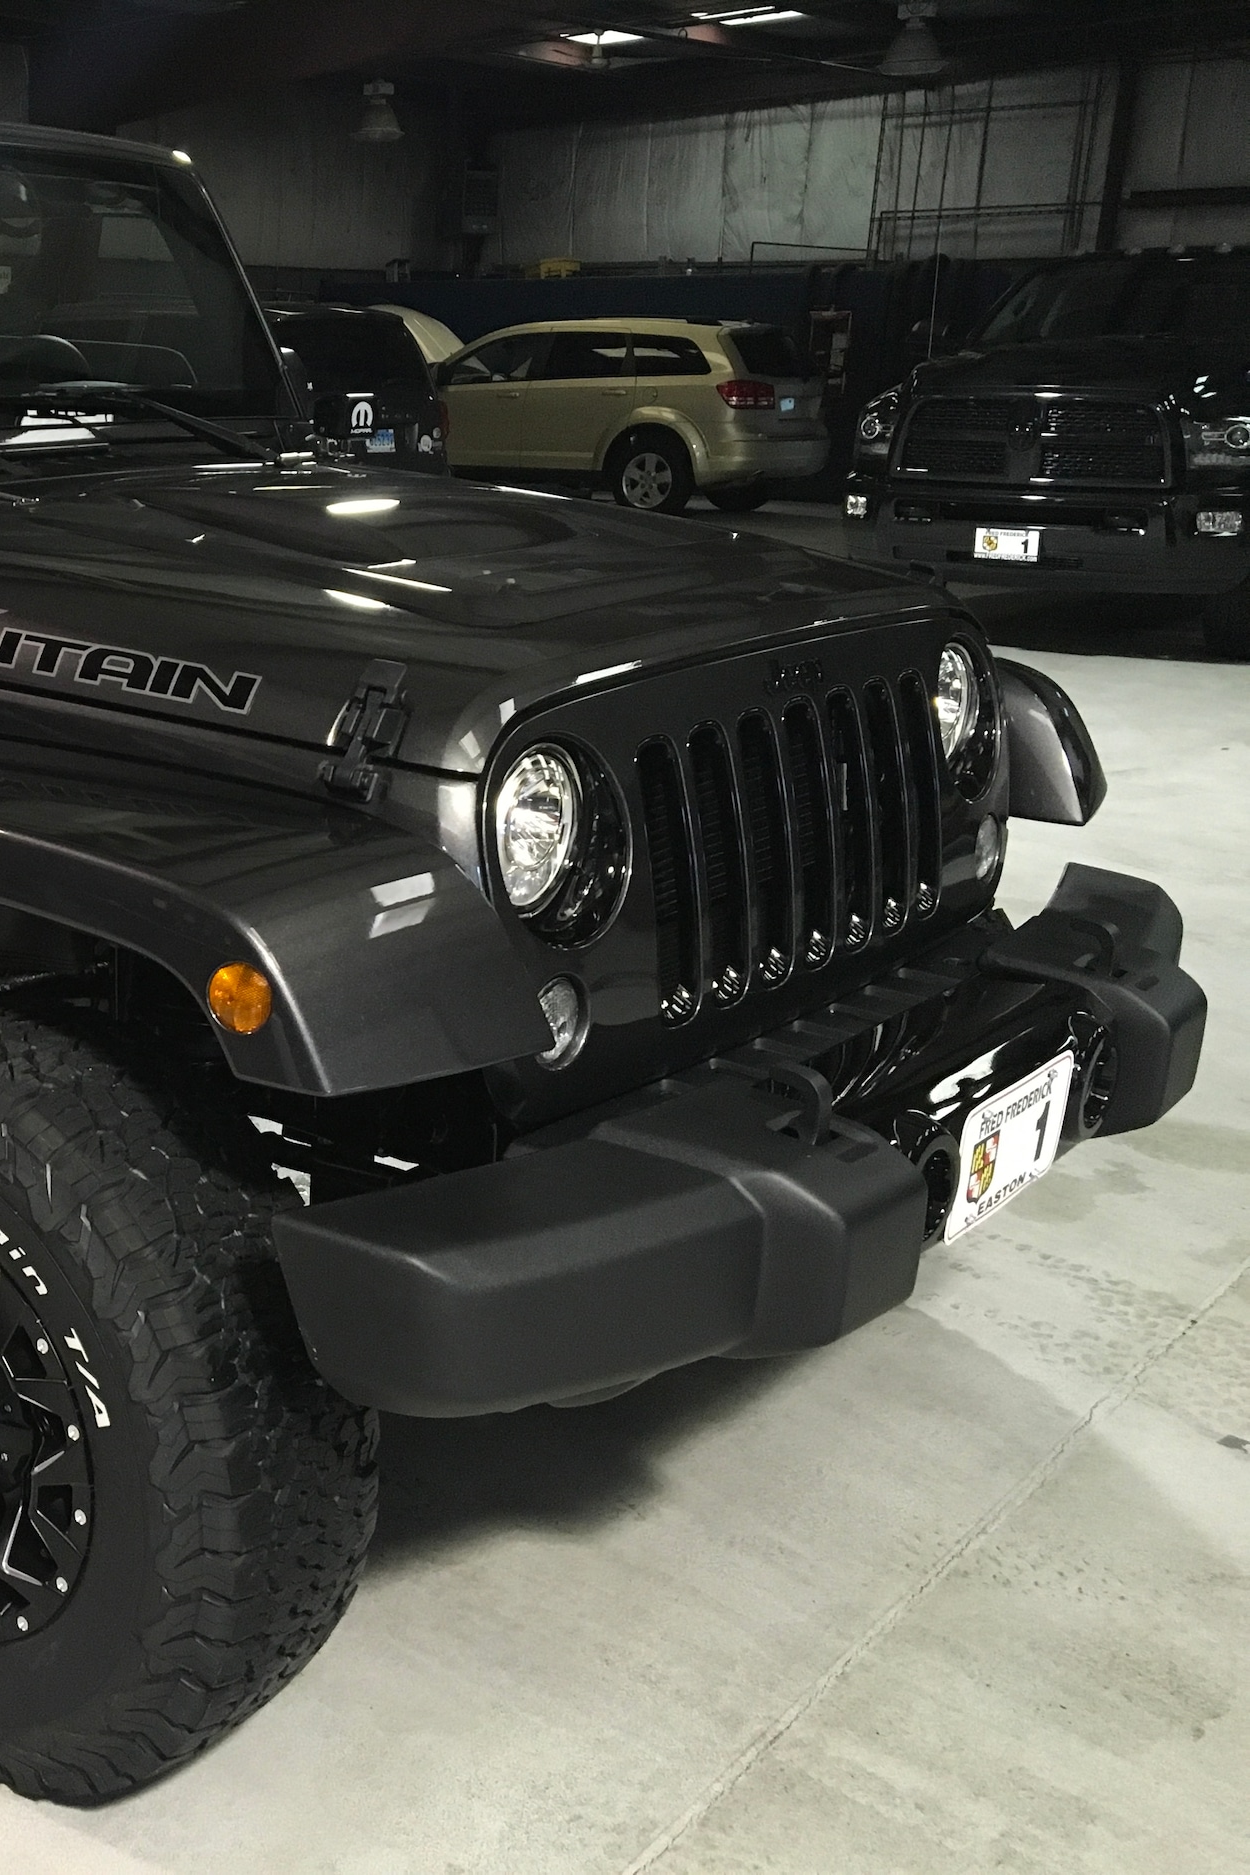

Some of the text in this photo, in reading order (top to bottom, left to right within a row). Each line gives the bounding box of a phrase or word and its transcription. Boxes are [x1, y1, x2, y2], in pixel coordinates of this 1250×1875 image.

[1021, 539, 1029, 554] 1
[979, 1080, 1054, 1139] FRED FREDERICK
[1033, 1099, 1052, 1163] 1
[977, 1171, 1027, 1216] EASTON
[64, 1326, 112, 1429] T/A
